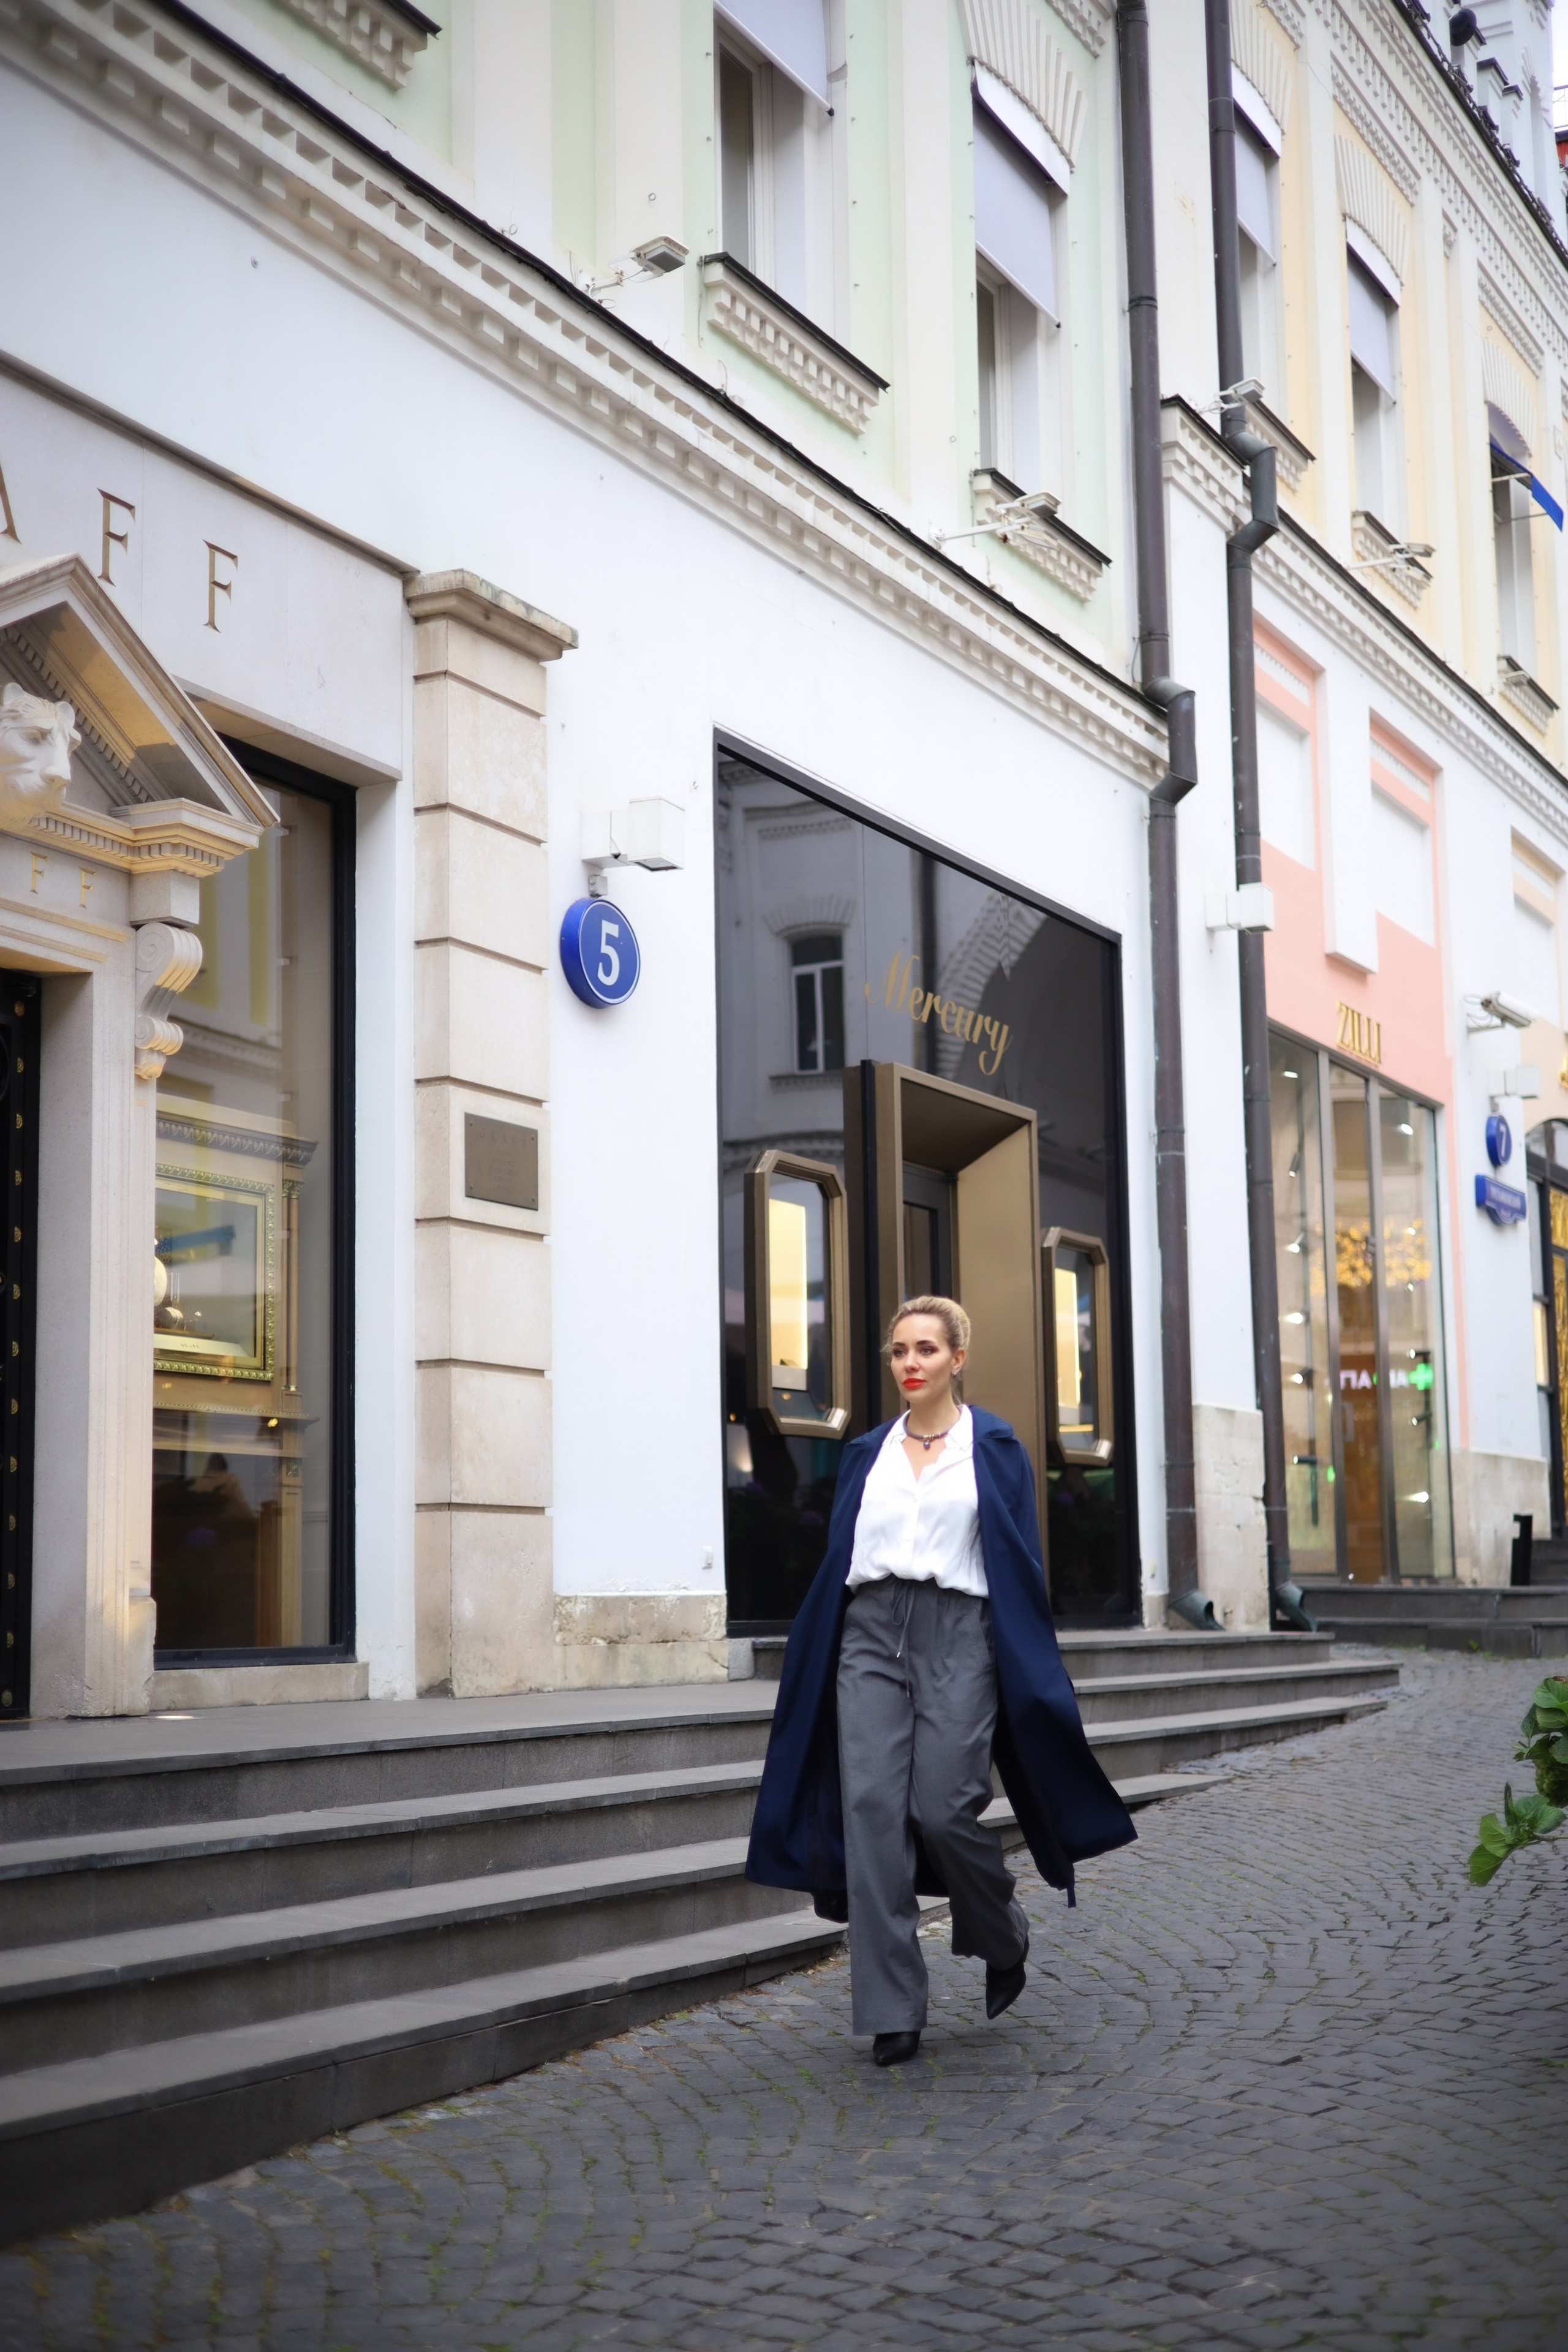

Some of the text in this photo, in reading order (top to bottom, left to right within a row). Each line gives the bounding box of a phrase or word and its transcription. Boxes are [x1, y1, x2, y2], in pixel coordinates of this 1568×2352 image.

[597, 919, 620, 986] 5
[864, 949, 1013, 1076] Mercury
[1336, 1001, 1381, 1066] ZILLI
[1499, 1123, 1507, 1158] 7
